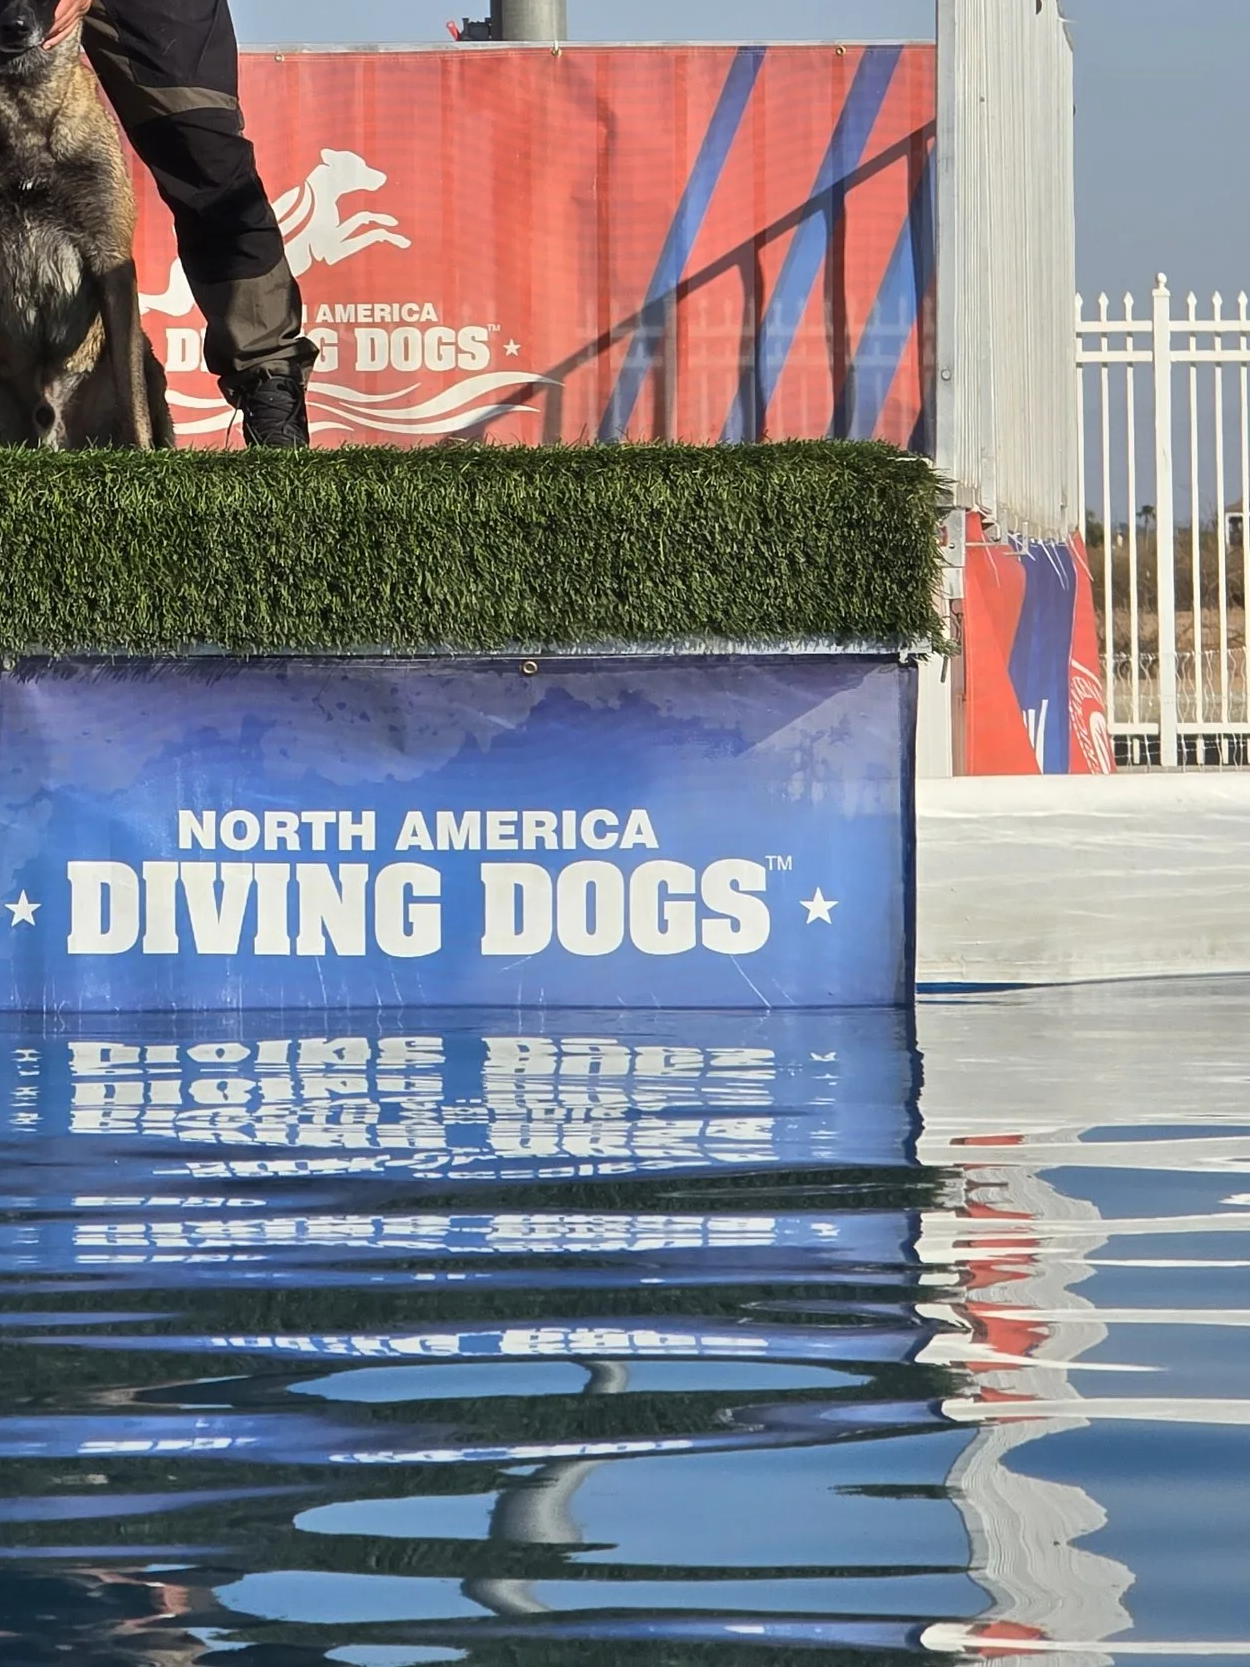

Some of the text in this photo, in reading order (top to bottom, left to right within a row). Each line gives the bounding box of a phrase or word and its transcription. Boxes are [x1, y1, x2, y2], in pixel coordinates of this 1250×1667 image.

[315, 302, 439, 323] AMERICA
[355, 325, 491, 371] DOGS
[178, 809, 659, 851] NORTH AMERICA
[67, 860, 442, 957] DIVING
[480, 858, 771, 956] DOGS
